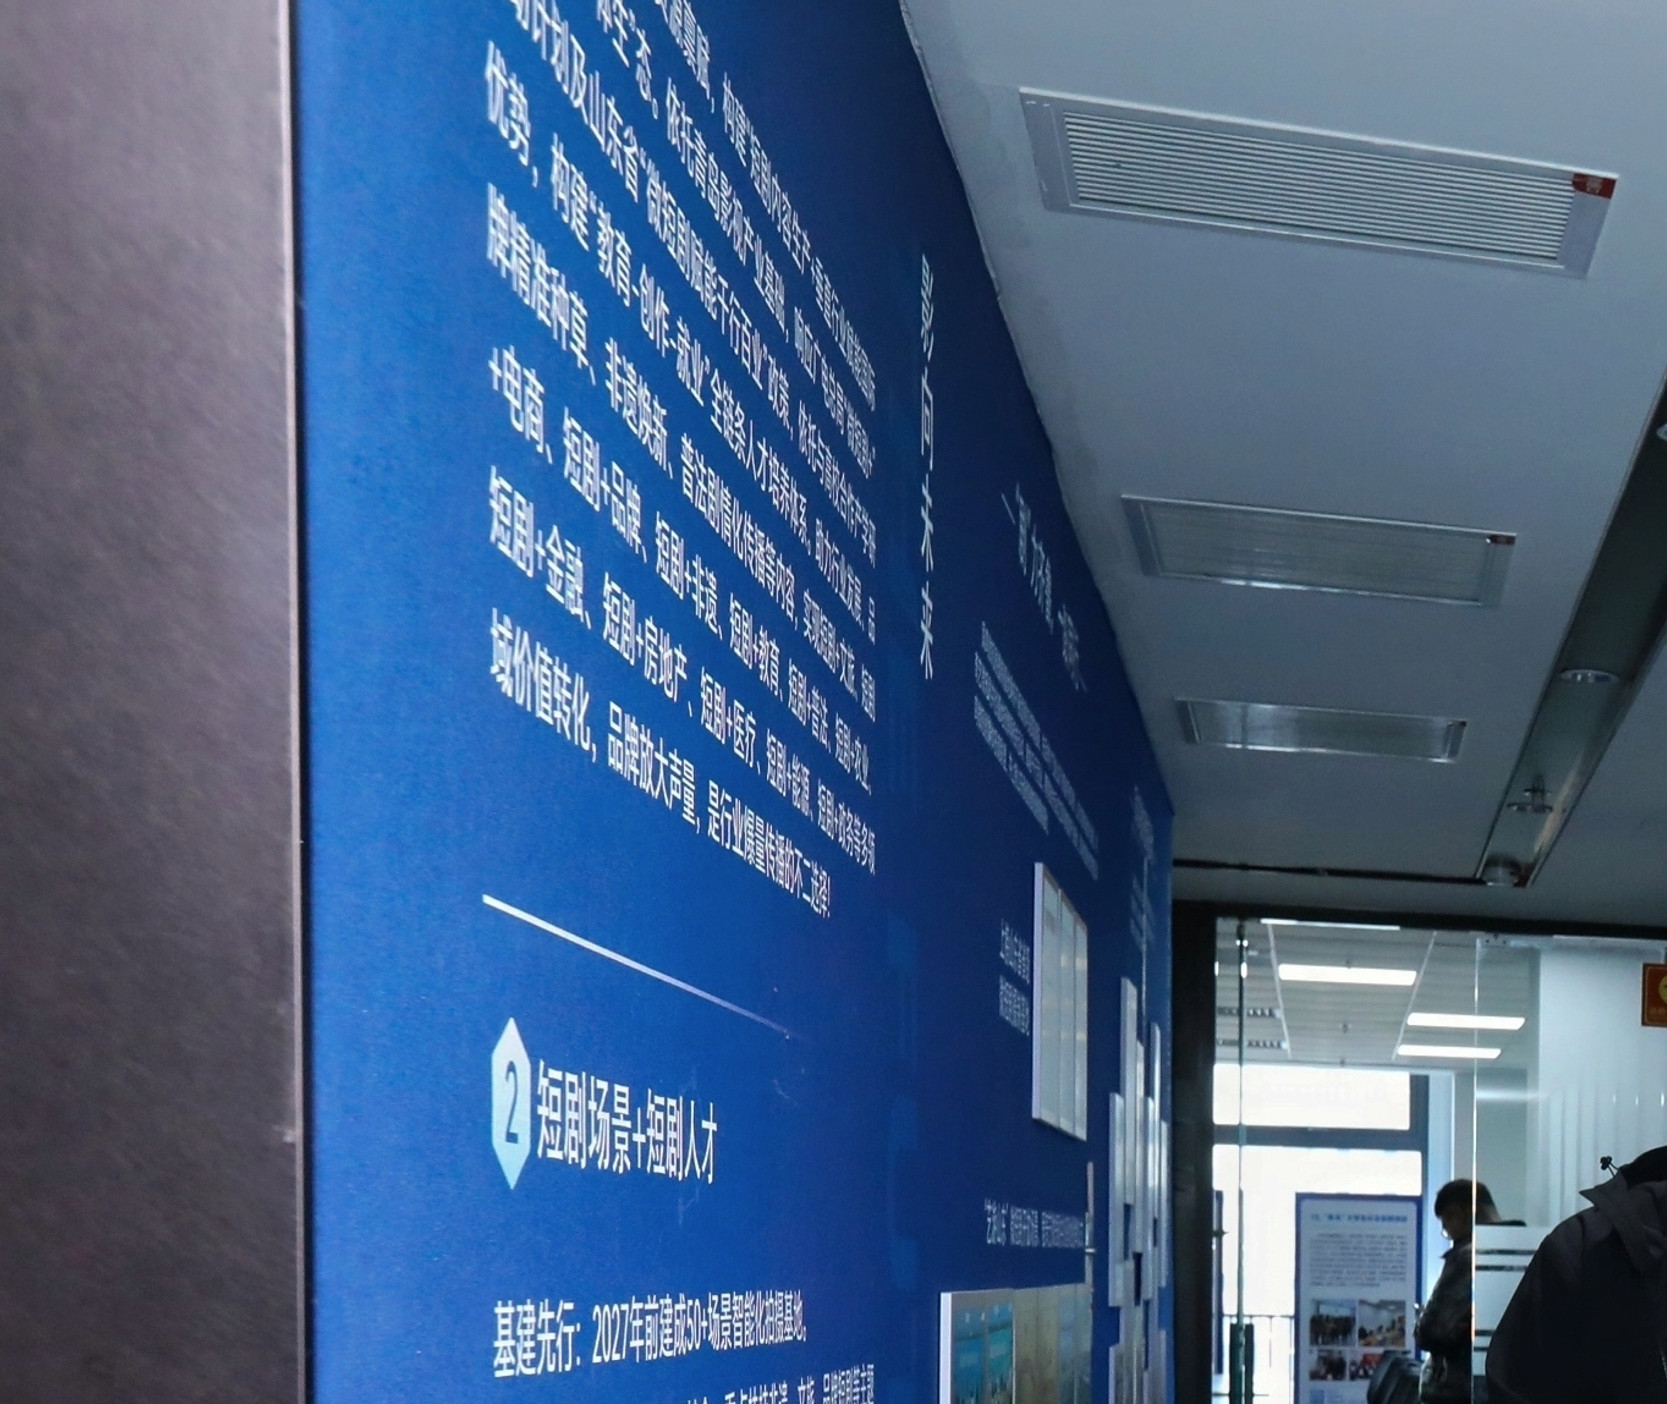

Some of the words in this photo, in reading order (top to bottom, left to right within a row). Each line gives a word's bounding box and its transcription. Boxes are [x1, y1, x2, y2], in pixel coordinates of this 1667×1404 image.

[920, 253, 935, 680] 影向未来
[504, 1060, 520, 1145] 2
[536, 1058, 718, 1185] 短剧场景+短剧人才
